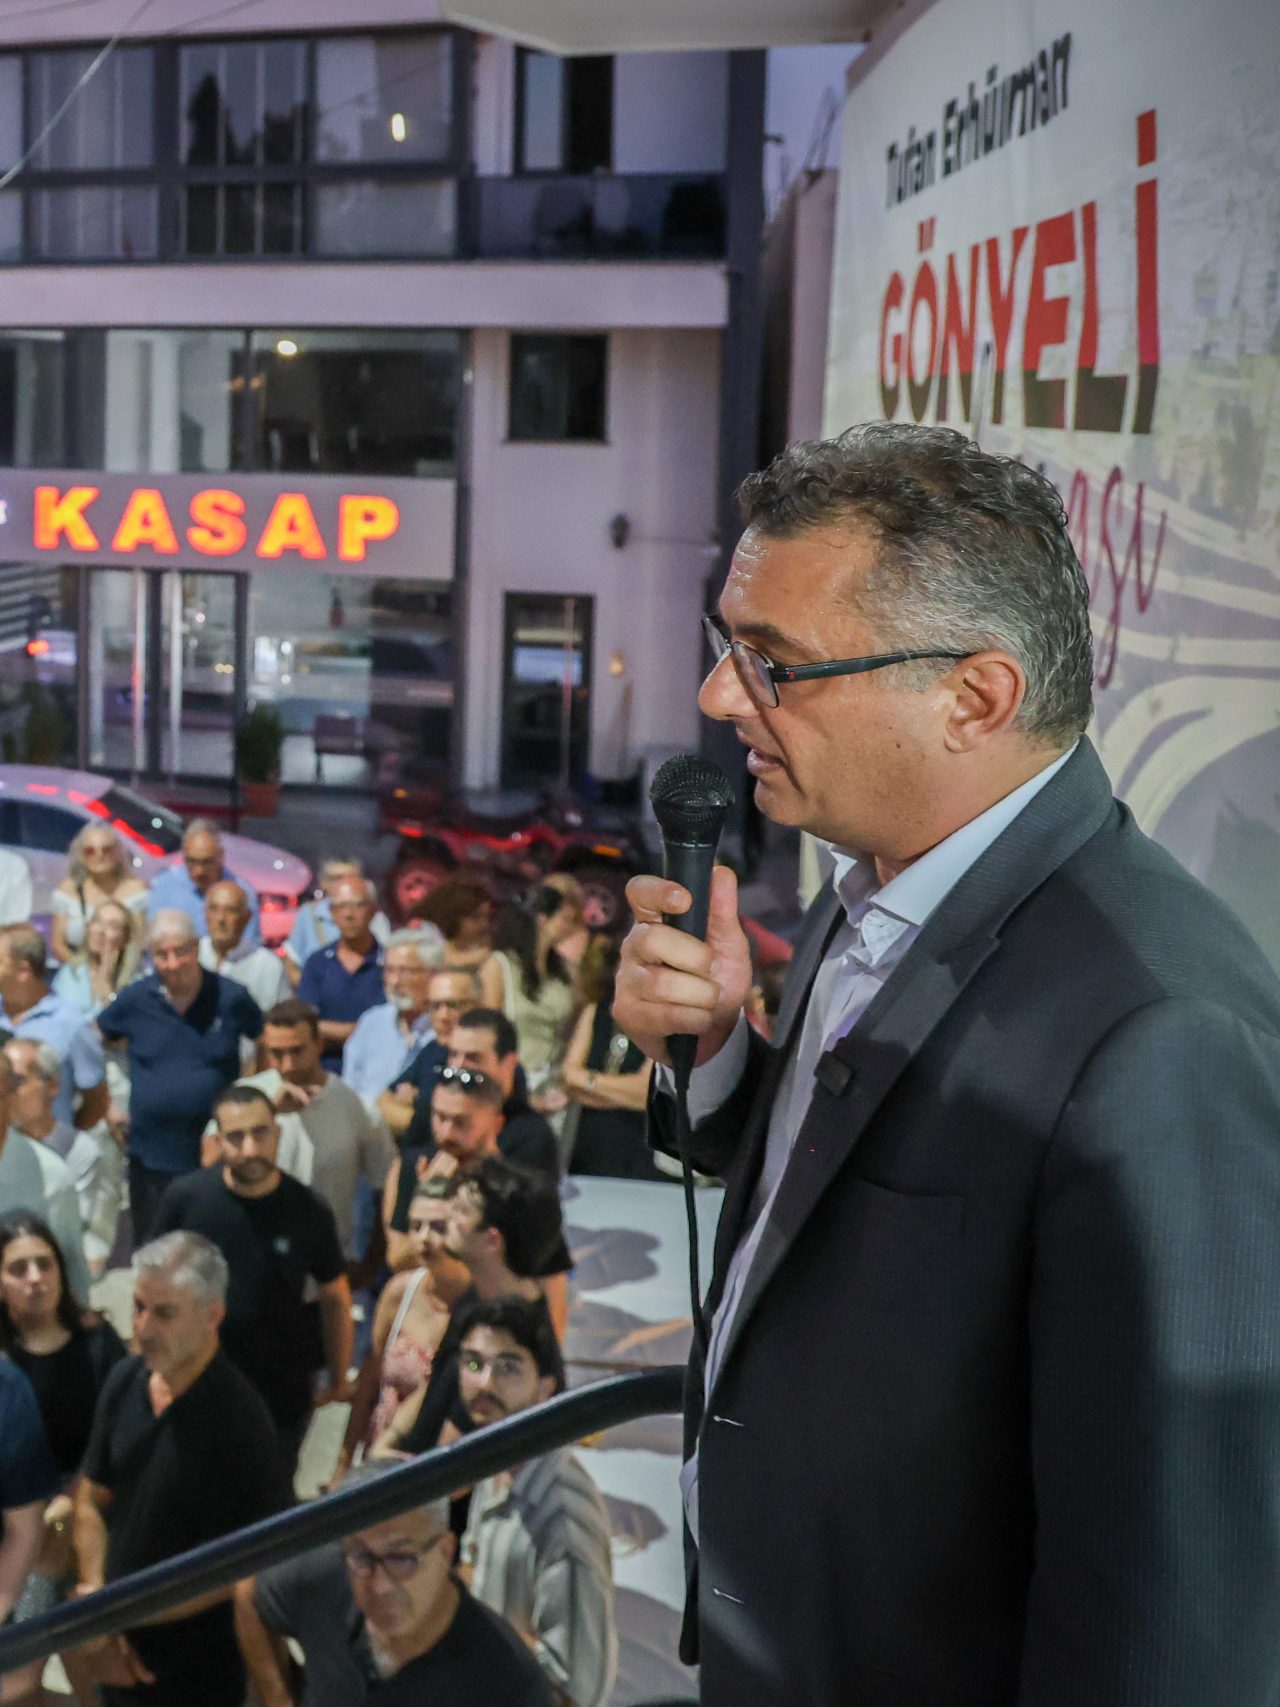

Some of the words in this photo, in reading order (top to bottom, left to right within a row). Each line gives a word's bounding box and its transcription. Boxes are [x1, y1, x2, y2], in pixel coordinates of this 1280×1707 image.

[941, 32, 1072, 178] Erhürman
[880, 108, 1160, 434] GÖNYELİ
[33, 485, 400, 562] KASAP
